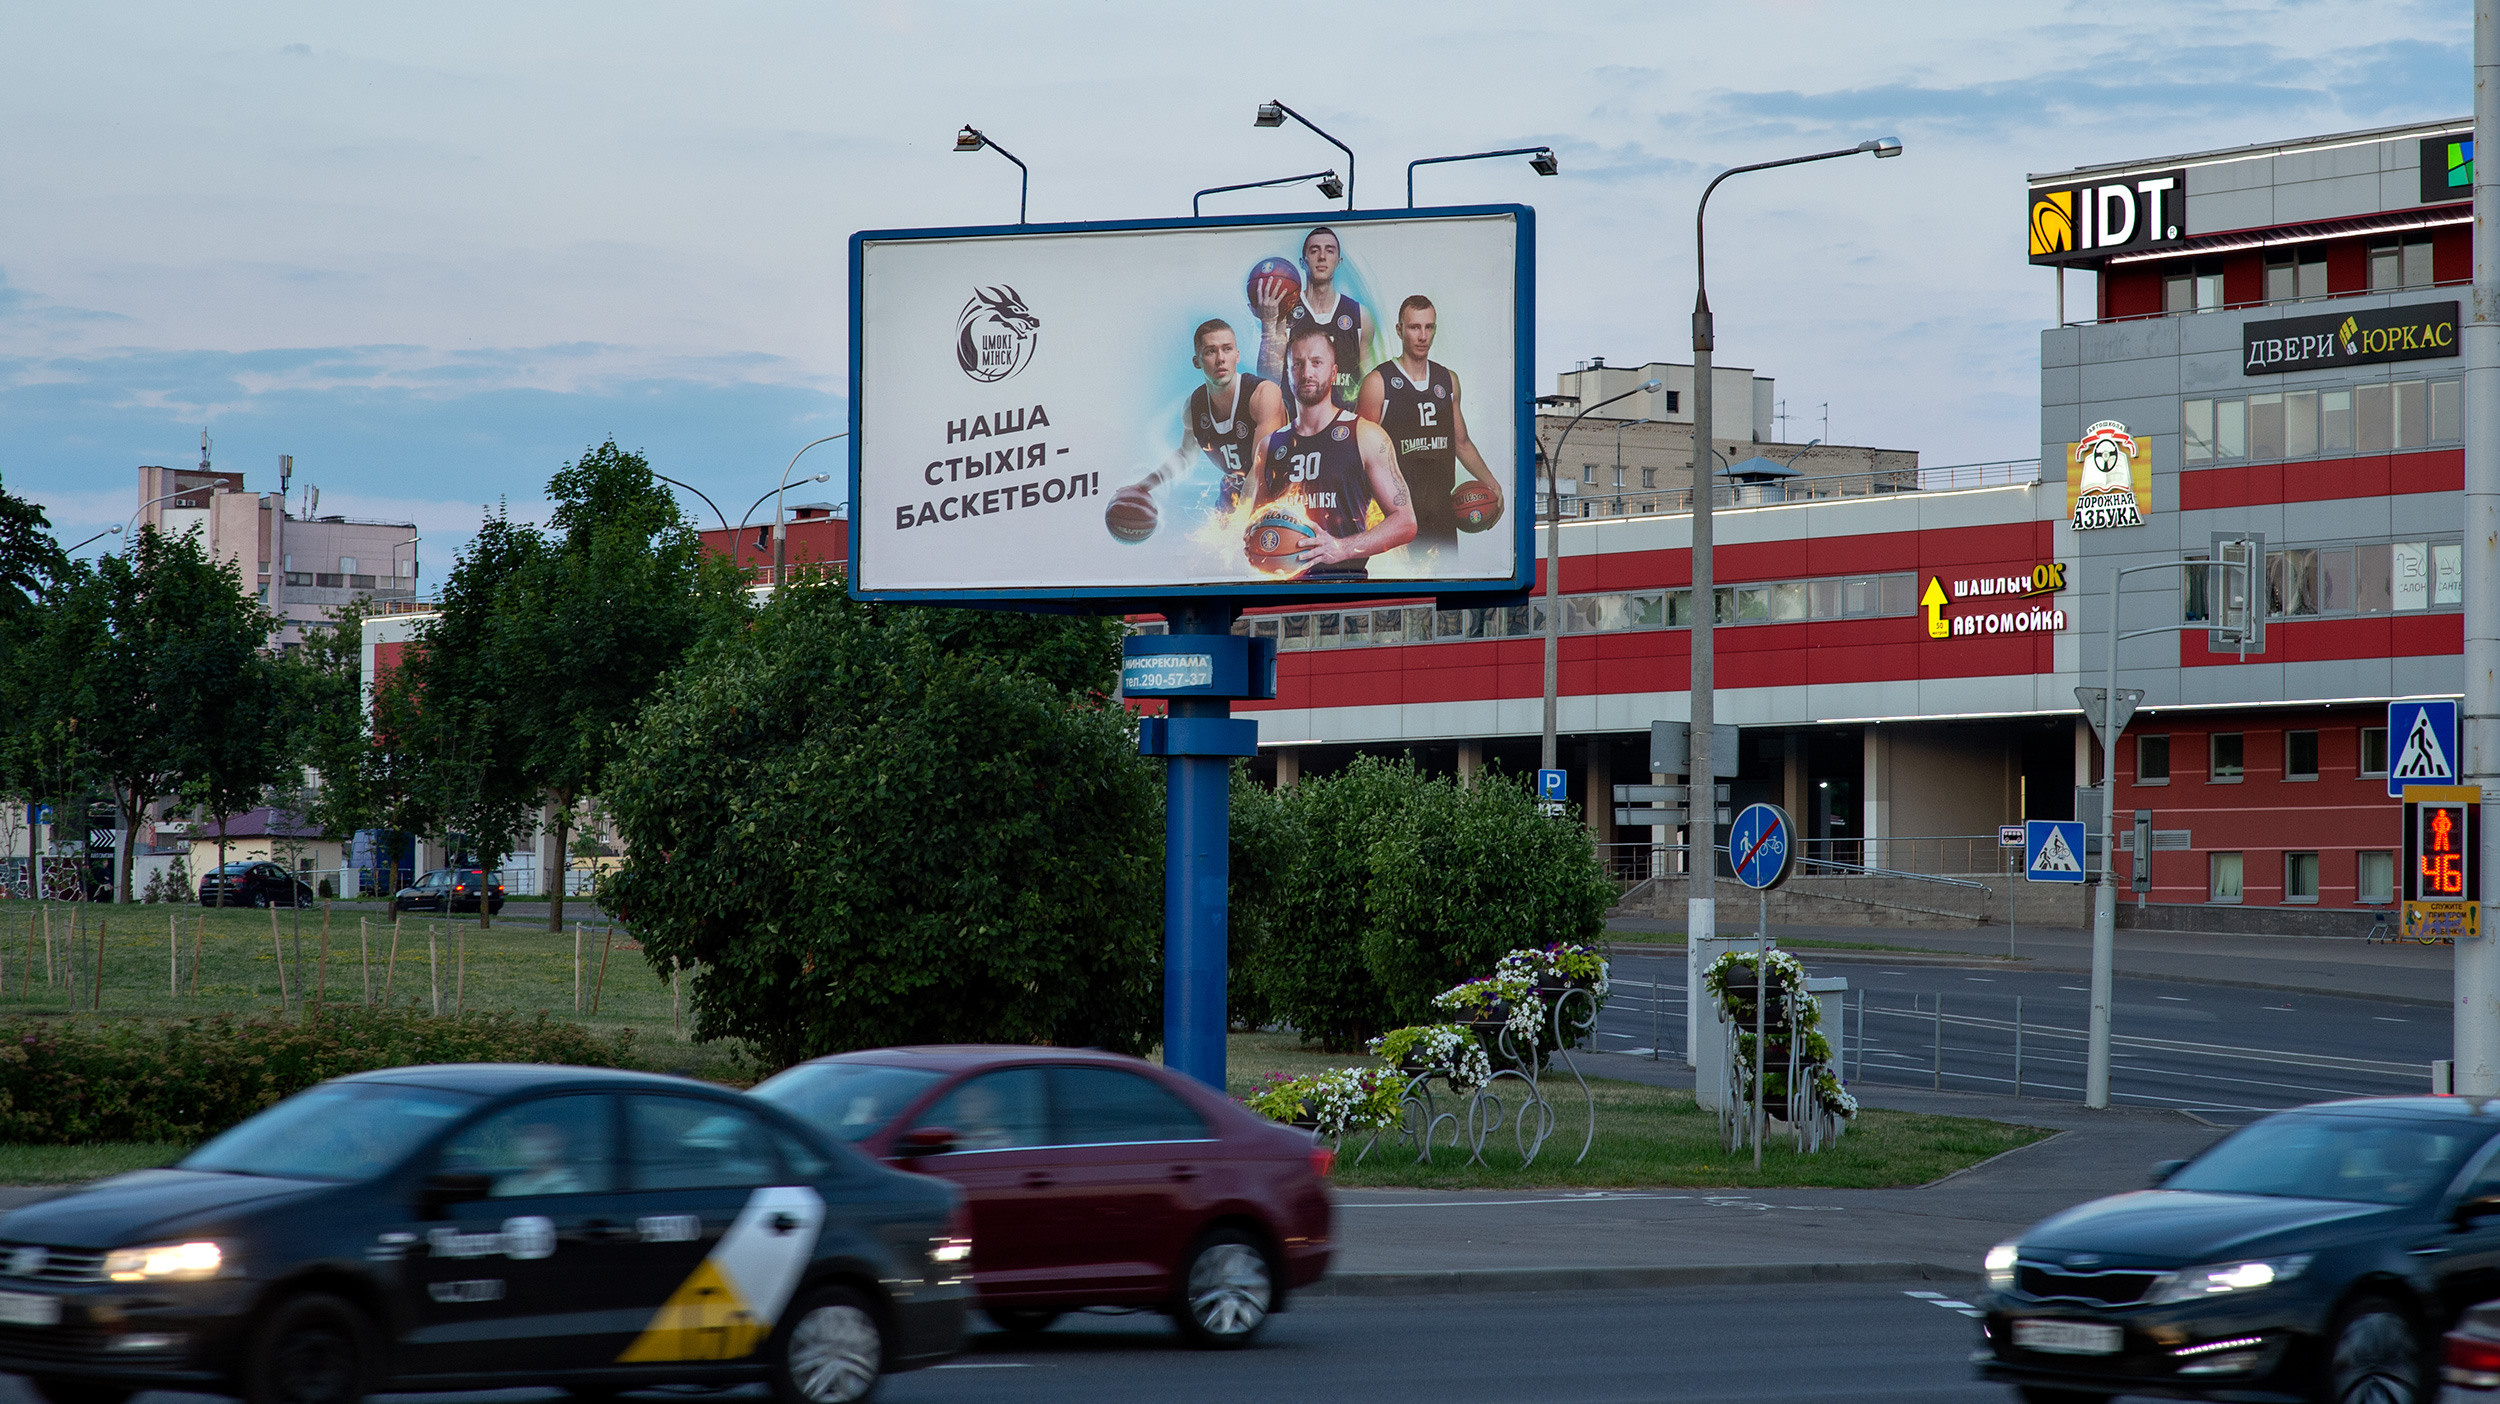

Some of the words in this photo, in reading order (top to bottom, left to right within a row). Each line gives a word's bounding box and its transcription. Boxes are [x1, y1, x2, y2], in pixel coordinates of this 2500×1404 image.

[982, 335, 1012, 350] ЦМОКІ
[2246, 333, 2334, 369] ДВЕРИ
[2361, 322, 2453, 354] ЮРКАС
[982, 350, 1012, 365] МІНСК
[947, 404, 1050, 444] НАША
[1417, 402, 1437, 427] 12
[2088, 422, 2124, 433] АВТОШКОЛА
[924, 442, 1046, 486] СТЫХІЯ
[1219, 443, 1242, 470] 15
[1289, 451, 1322, 483] 30
[896, 471, 1099, 530] БАСКЕТБОЛ!
[2076, 493, 2134, 510] ДОРОЖНАЯ
[1261, 510, 1298, 525] ilson
[2071, 507, 2141, 529] АЗБУКА
[1936, 622, 1943, 630] 50
[1953, 606, 2064, 636] АВТОМОЙКА
[1546, 773, 1561, 796] P
[2421, 854, 2461, 892] 46
